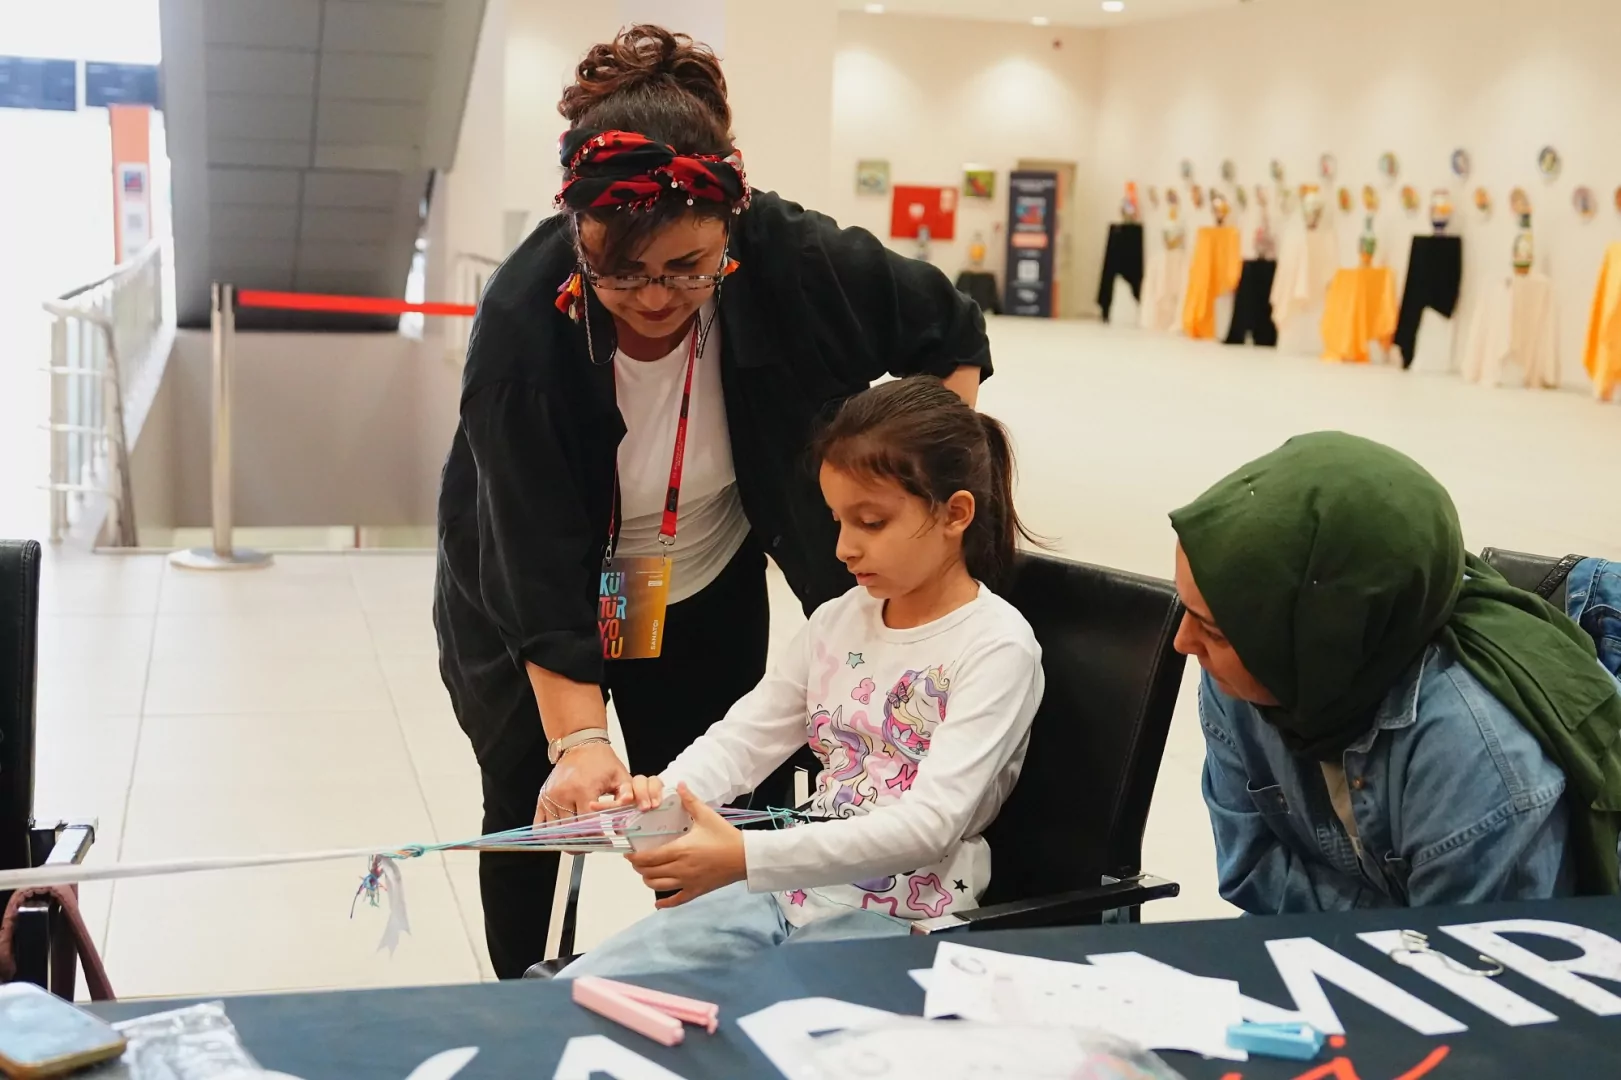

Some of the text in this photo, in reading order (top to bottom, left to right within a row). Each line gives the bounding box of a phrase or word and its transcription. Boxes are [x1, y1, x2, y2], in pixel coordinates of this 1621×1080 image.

[600, 596, 627, 620] TÜR
[598, 619, 620, 641] YO
[602, 636, 624, 659] LU
